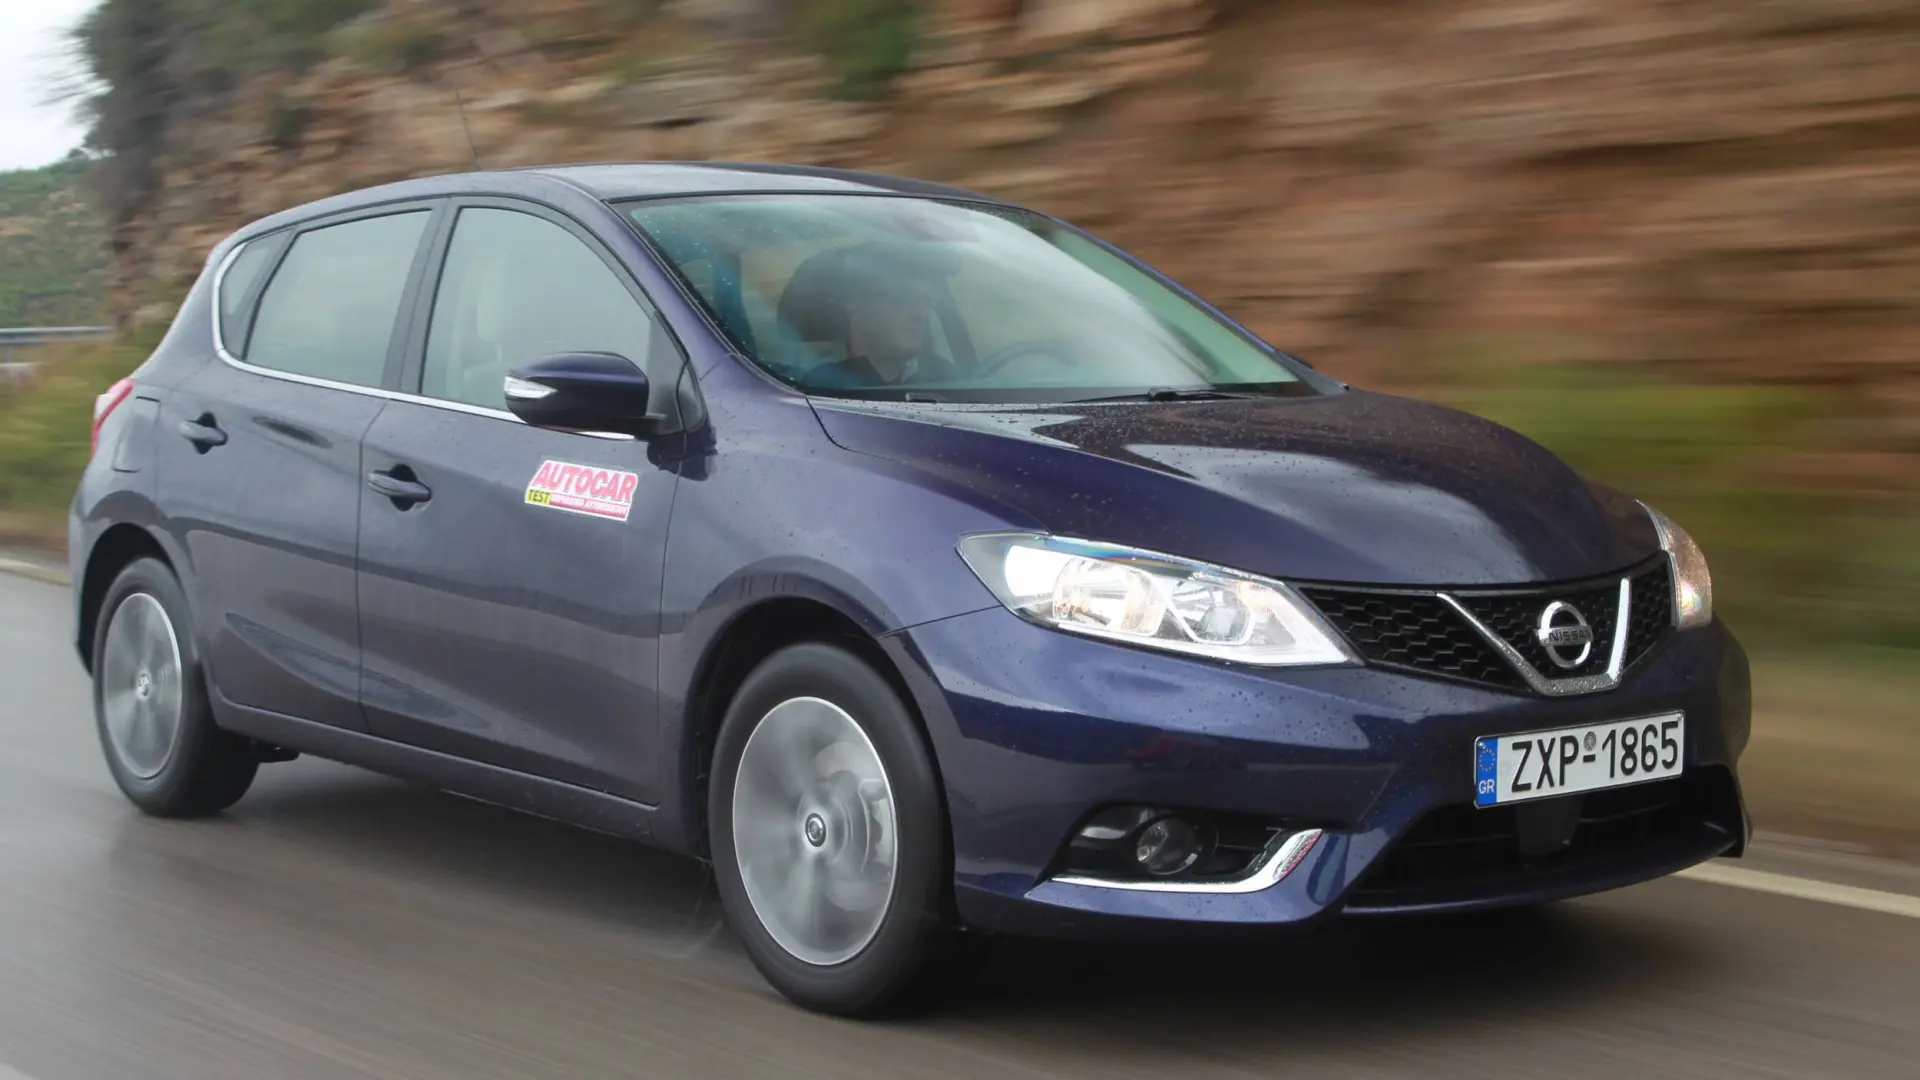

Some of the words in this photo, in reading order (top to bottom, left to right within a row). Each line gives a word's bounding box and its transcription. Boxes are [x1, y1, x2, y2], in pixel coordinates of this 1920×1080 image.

[531, 462, 636, 501] AUTOCAR
[528, 489, 551, 504] TEST
[1511, 720, 1679, 793] ZXP-1865
[1478, 779, 1496, 795] GR
